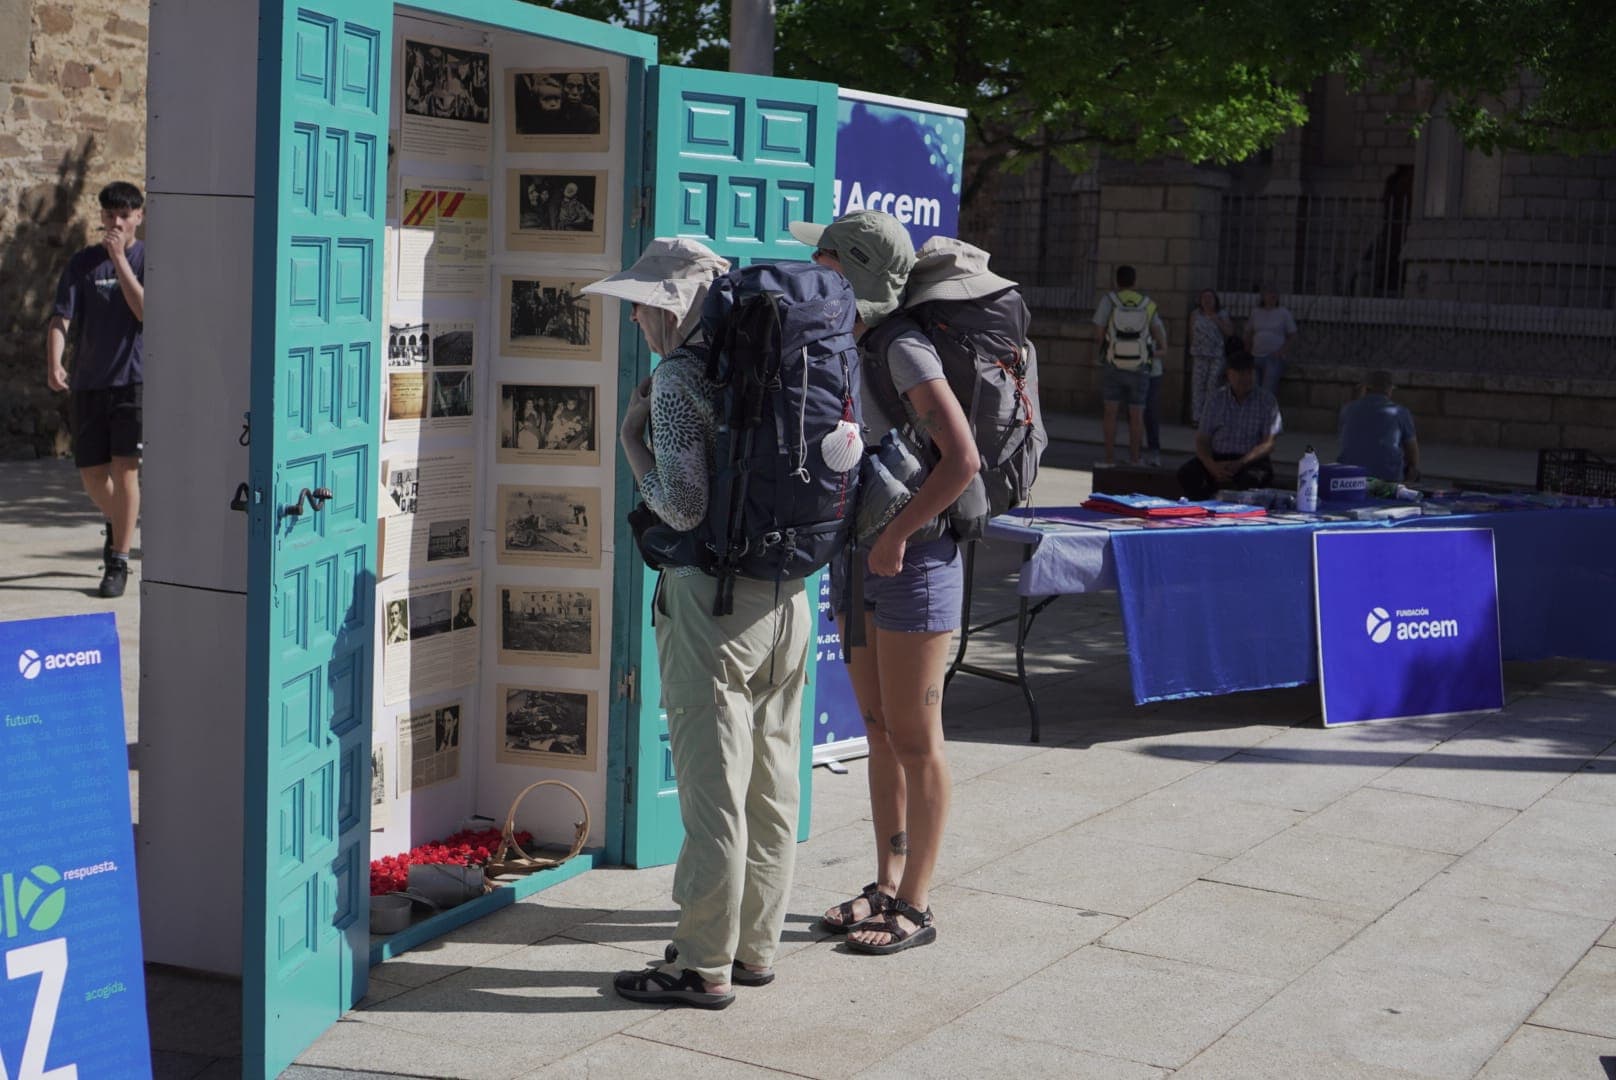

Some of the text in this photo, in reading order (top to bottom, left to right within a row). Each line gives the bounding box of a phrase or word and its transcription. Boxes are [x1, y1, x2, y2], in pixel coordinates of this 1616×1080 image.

[845, 181, 941, 227] Accem
[1339, 480, 1365, 489] Accem
[1396, 606, 1429, 617] FUNDACIÓN
[1396, 619, 1458, 641] accem
[44, 649, 102, 670] accem
[5, 714, 42, 728] futuro,
[63, 861, 118, 881] respuesta,
[85, 981, 127, 1001] acogida,
